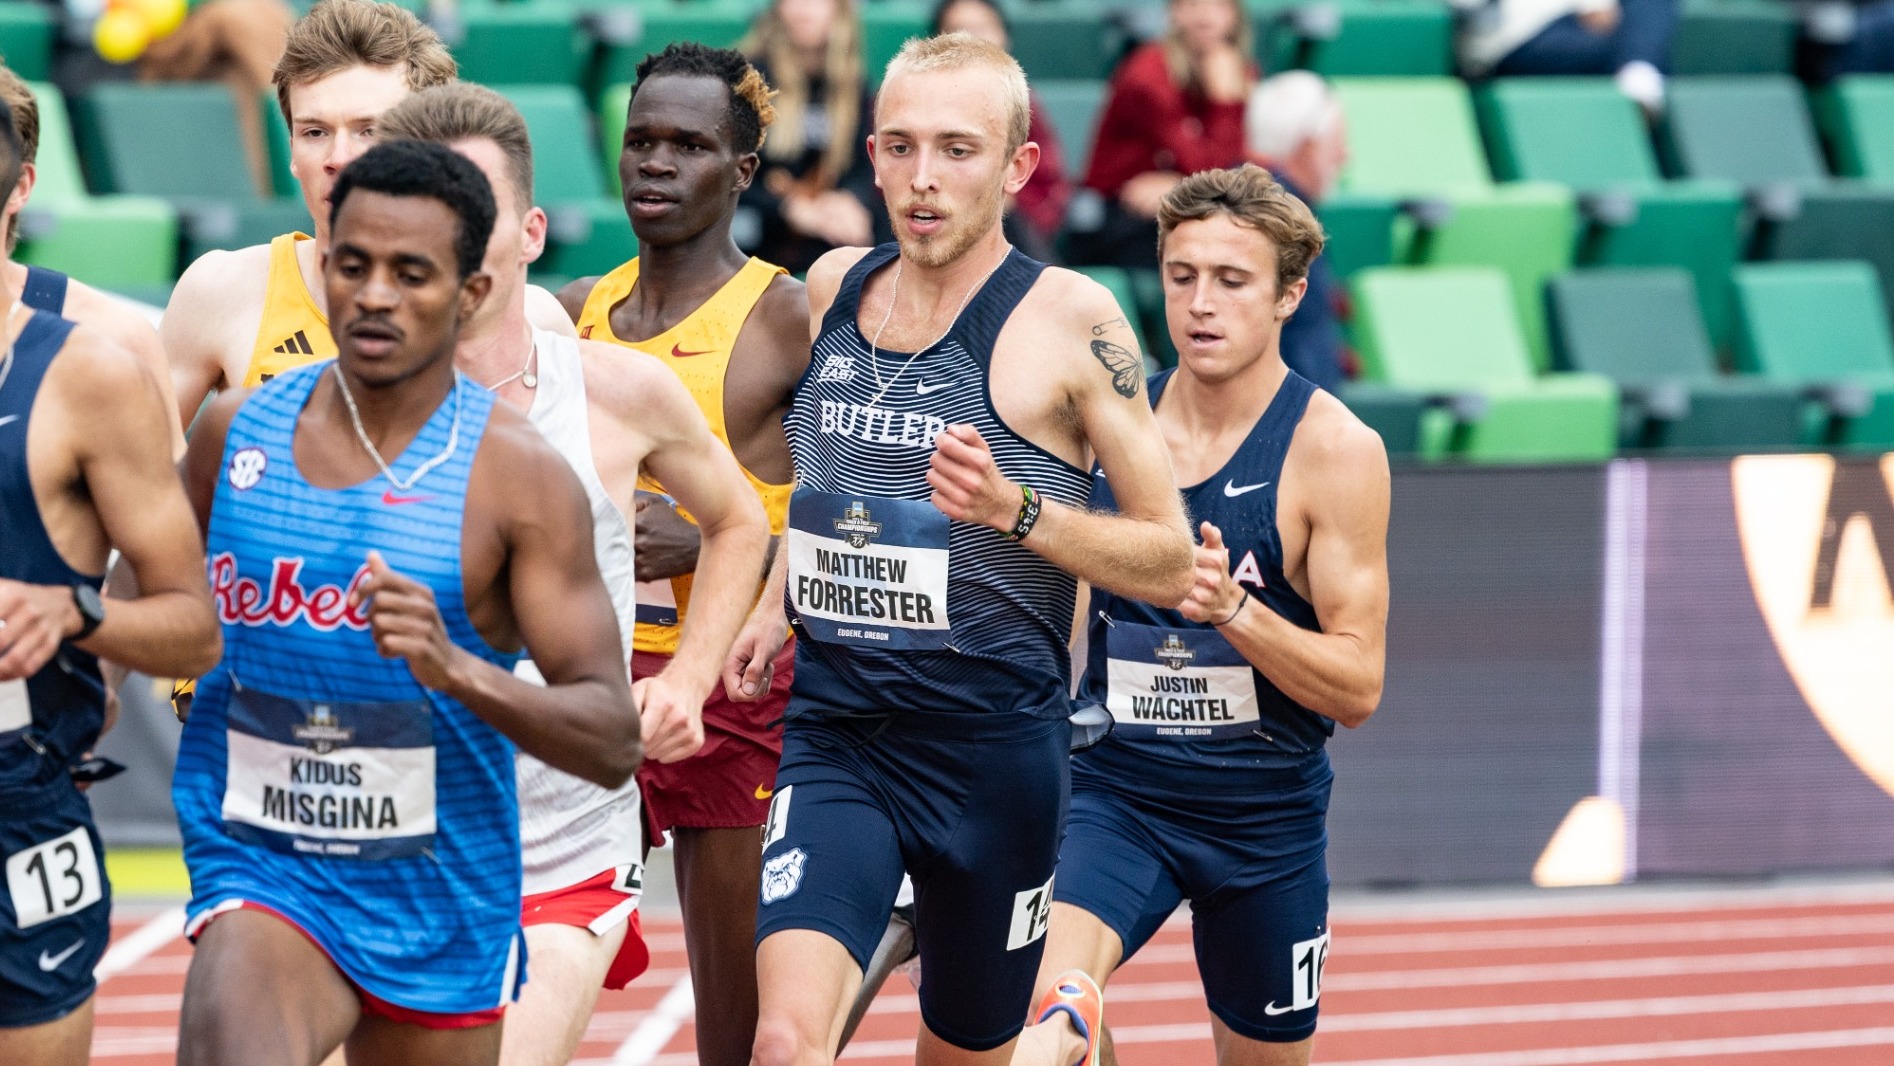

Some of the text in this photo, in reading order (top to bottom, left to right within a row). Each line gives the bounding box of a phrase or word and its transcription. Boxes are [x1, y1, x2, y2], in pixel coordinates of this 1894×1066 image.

[819, 366, 859, 381] EAST
[825, 355, 855, 368] BIG
[820, 400, 945, 448] BUTLER
[816, 547, 907, 583] MATTHEW
[1225, 549, 1266, 588] A
[797, 575, 935, 623] FORRESTER
[864, 630, 889, 641] OREGON
[1150, 675, 1208, 694] JUSTIN
[1132, 695, 1234, 721] WACHTEL
[1185, 727, 1211, 736] OREGON
[290, 757, 362, 787] KIDUS
[262, 785, 398, 830] MISGINA
[764, 796, 778, 843] 4
[25, 840, 84, 914] 13
